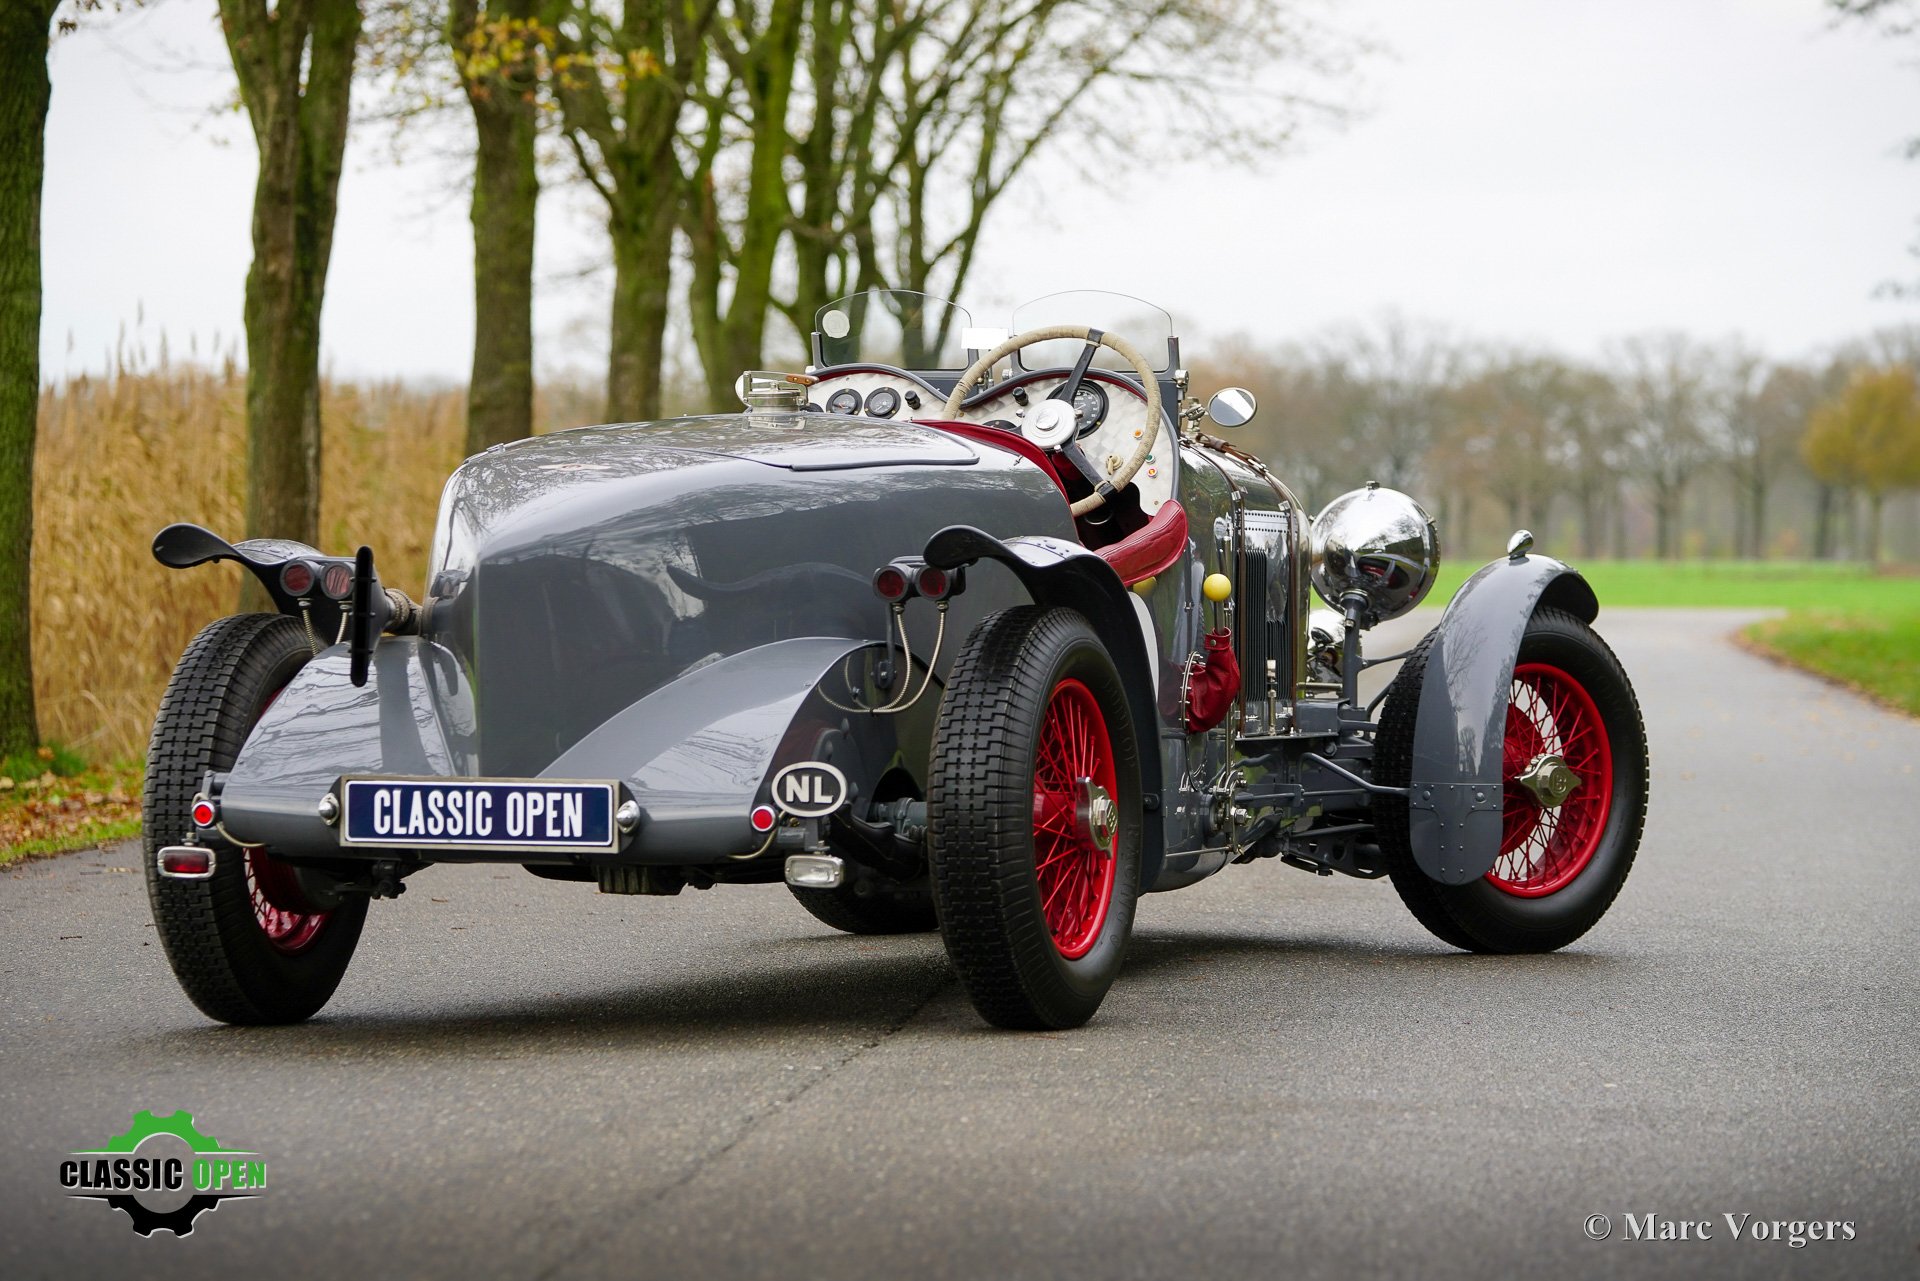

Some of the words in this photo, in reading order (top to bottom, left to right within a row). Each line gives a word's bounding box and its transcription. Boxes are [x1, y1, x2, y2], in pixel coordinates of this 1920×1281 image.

[786, 774, 834, 804] NL
[373, 789, 493, 837] CLASSIC
[506, 791, 583, 838] OPEN
